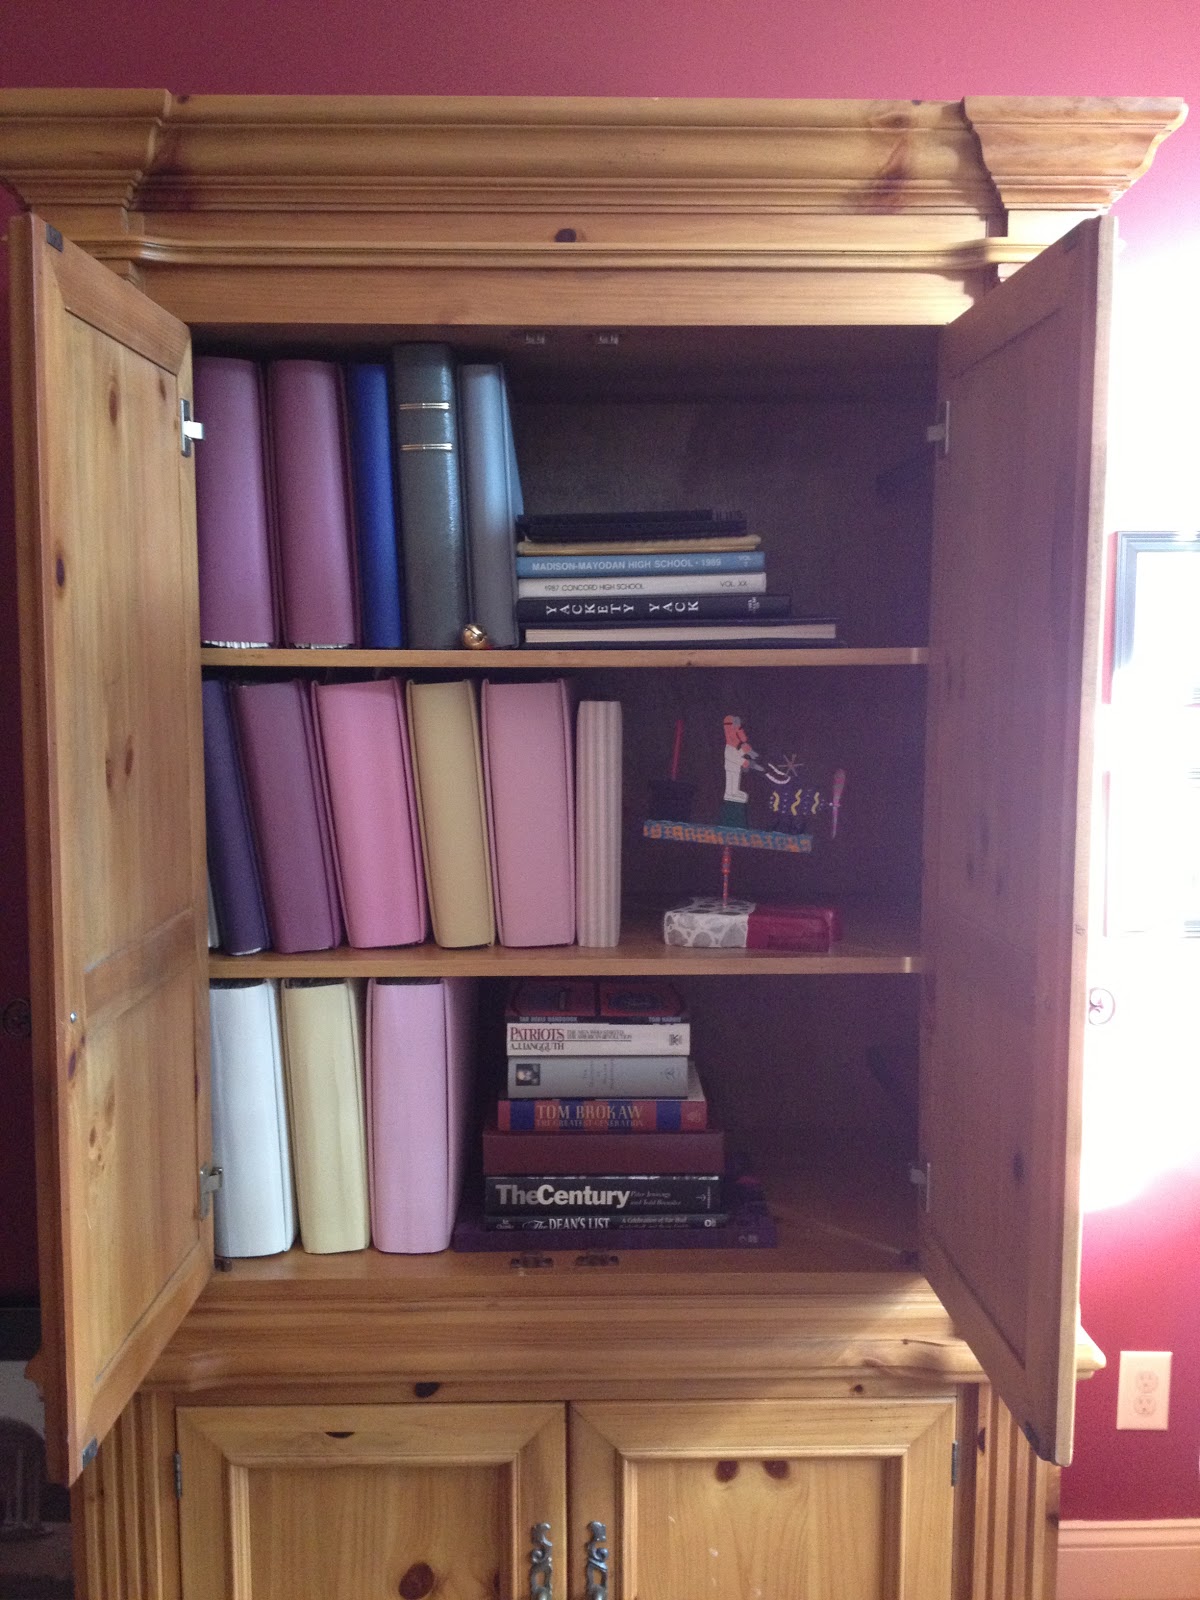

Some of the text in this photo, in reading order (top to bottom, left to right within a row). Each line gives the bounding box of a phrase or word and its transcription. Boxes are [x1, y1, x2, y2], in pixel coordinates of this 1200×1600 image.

[532, 561, 625, 571] MADISON-MAYODAN
[628, 560, 651, 569] HIGH
[654, 559, 694, 568] SCHOOL
[561, 584, 598, 592] CONCORD
[599, 583, 616, 591] HIGH
[616, 582, 644, 590] SCHOOL
[545, 600, 699, 616] YACKETY YACK
[510, 1027, 565, 1042] PATRIOTS
[536, 1104, 644, 1120] TOM BROKAW
[548, 1217, 586, 1231] DEAN'S
[588, 1217, 611, 1230] LIST
